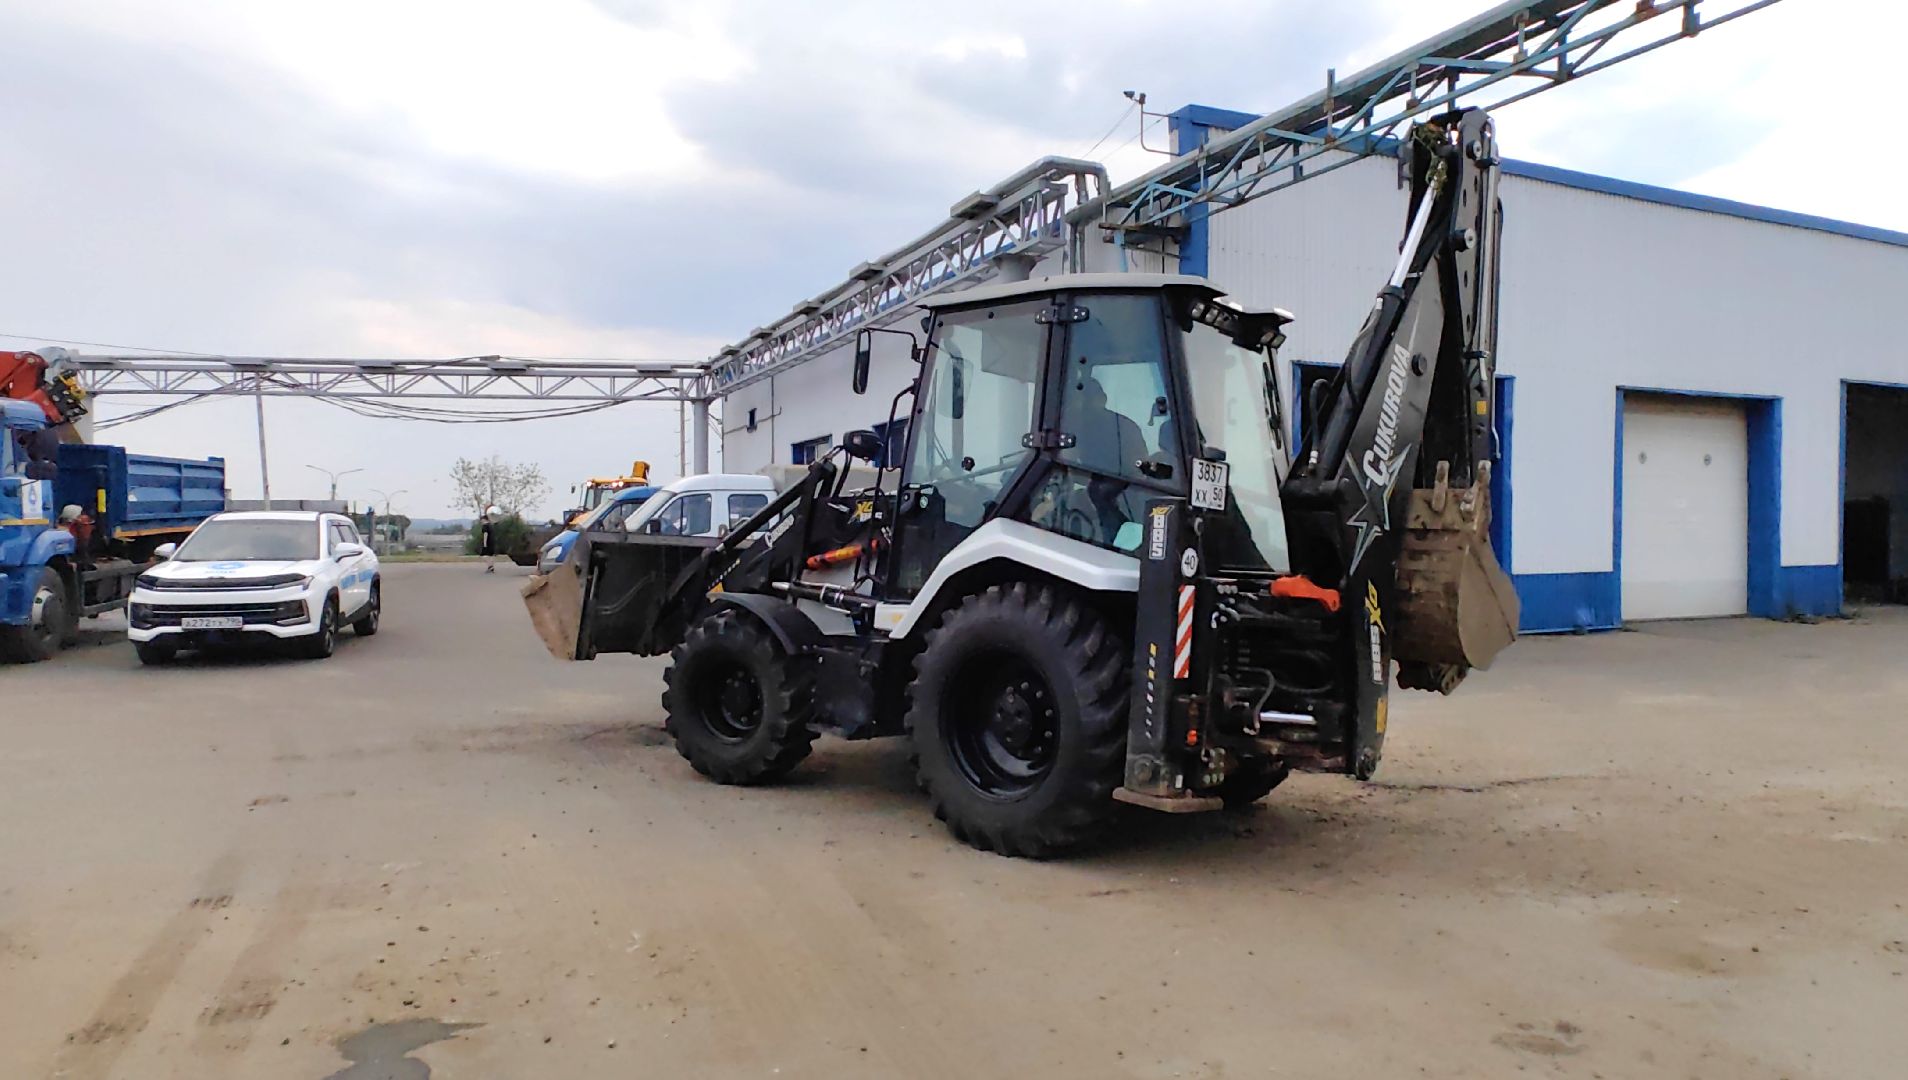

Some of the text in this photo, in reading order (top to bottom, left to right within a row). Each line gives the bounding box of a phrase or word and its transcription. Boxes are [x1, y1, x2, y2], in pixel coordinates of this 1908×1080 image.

[1198, 462, 1223, 483] 3837
[1213, 487, 1223, 501] 50
[1151, 514, 1164, 557] 885
[1184, 554, 1196, 570] 40
